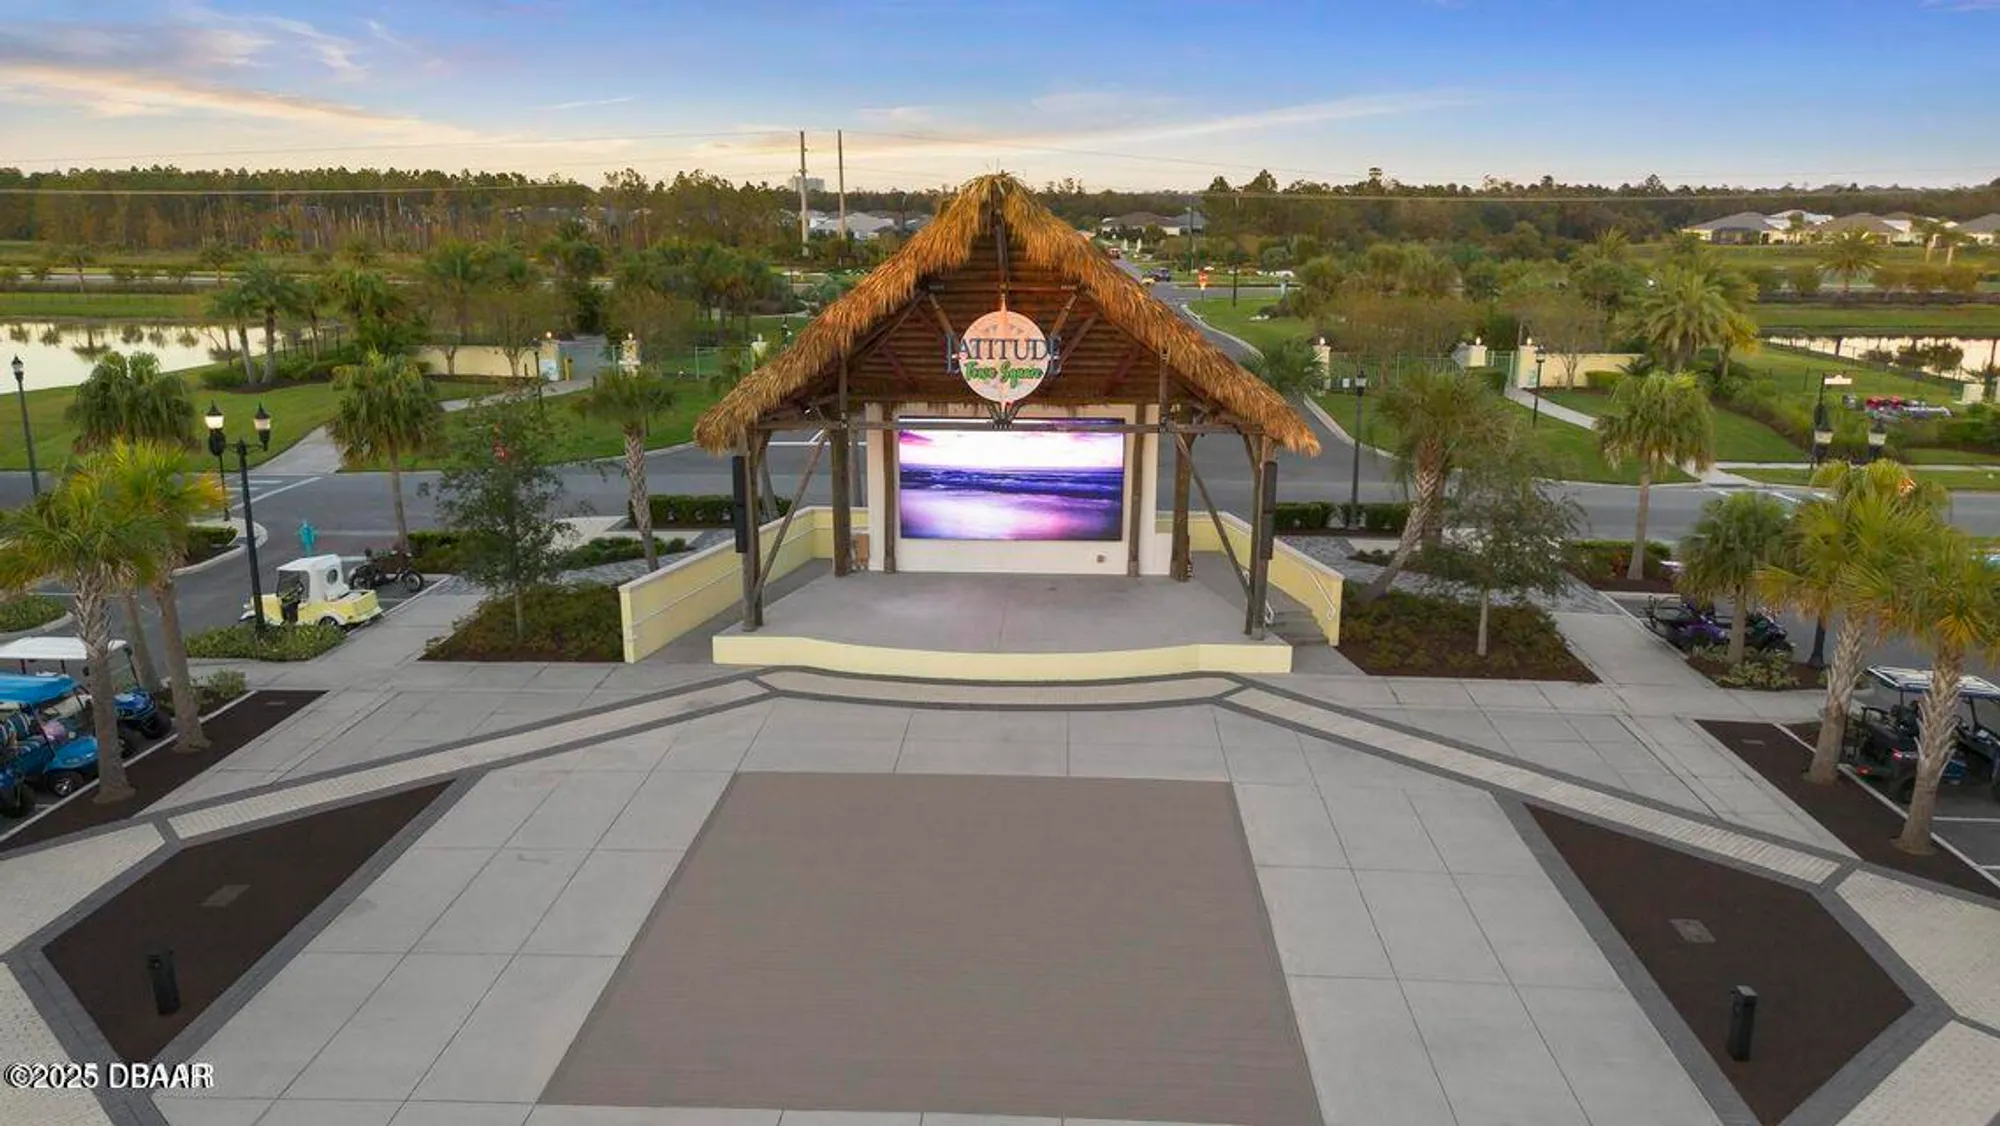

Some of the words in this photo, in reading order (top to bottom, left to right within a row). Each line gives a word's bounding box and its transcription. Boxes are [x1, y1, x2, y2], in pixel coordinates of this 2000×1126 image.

[946, 336, 1062, 374] LATITUDE
[965, 361, 998, 380] Town
[999, 360, 1045, 388] Square
